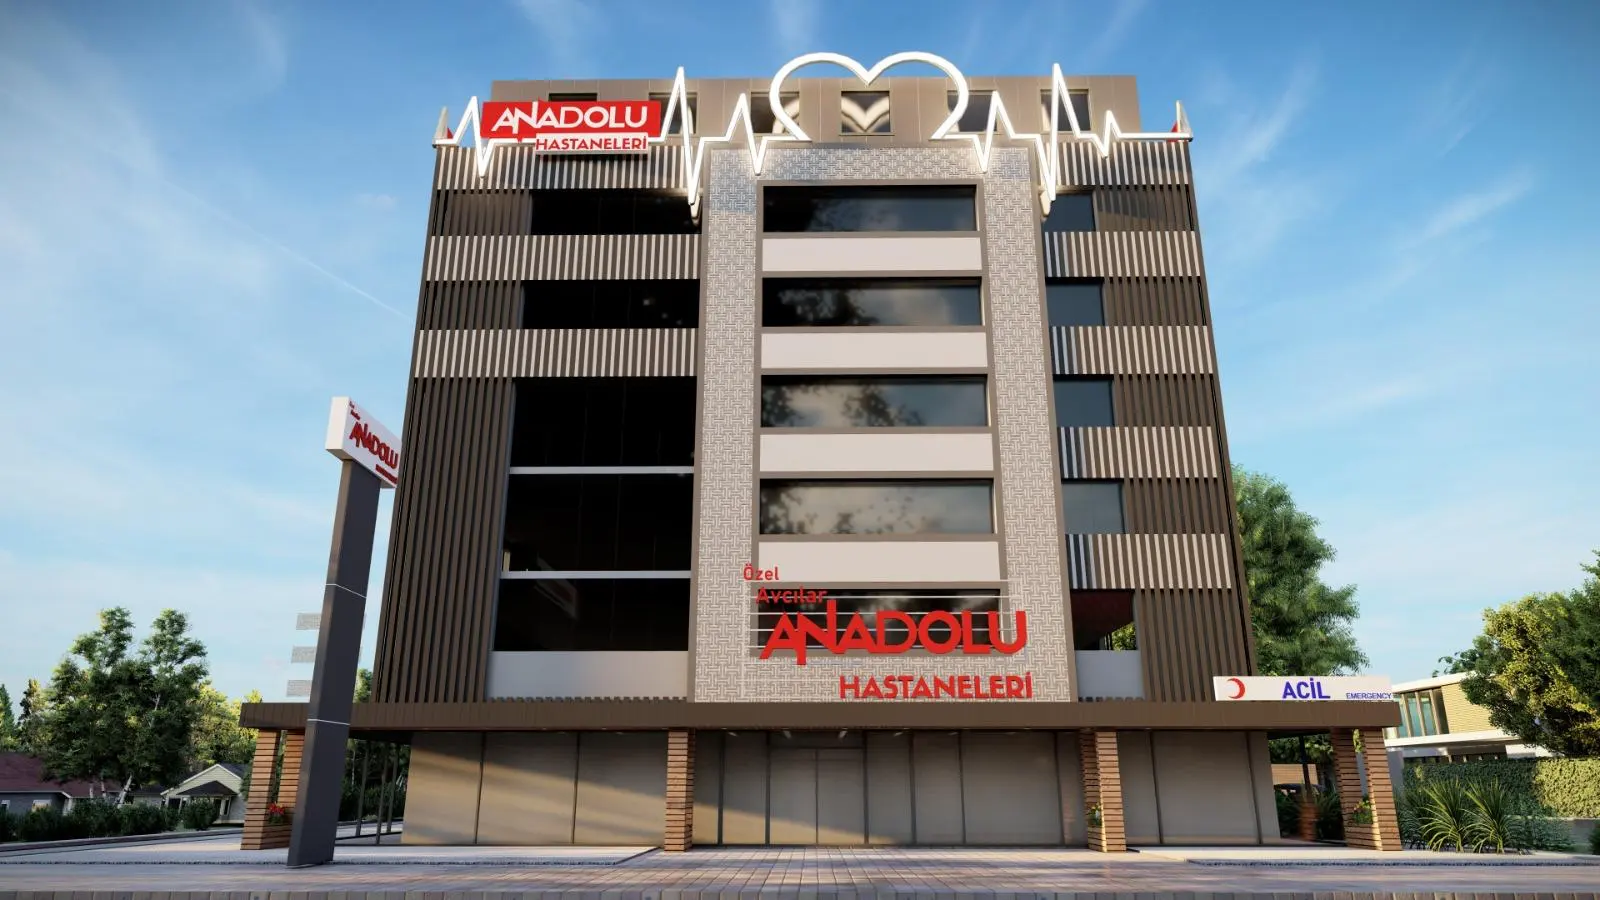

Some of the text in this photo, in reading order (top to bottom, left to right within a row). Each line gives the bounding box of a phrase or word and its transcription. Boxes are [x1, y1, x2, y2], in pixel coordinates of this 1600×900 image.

[491, 101, 648, 134] ANADOLU
[536, 135, 647, 150] HASTANELERİ
[743, 564, 779, 580] Özel
[755, 586, 827, 604] Avcılar
[759, 599, 1027, 665] ANADOLU
[839, 671, 1033, 699] HASTANELERİ
[1282, 677, 1330, 699] ACİL
